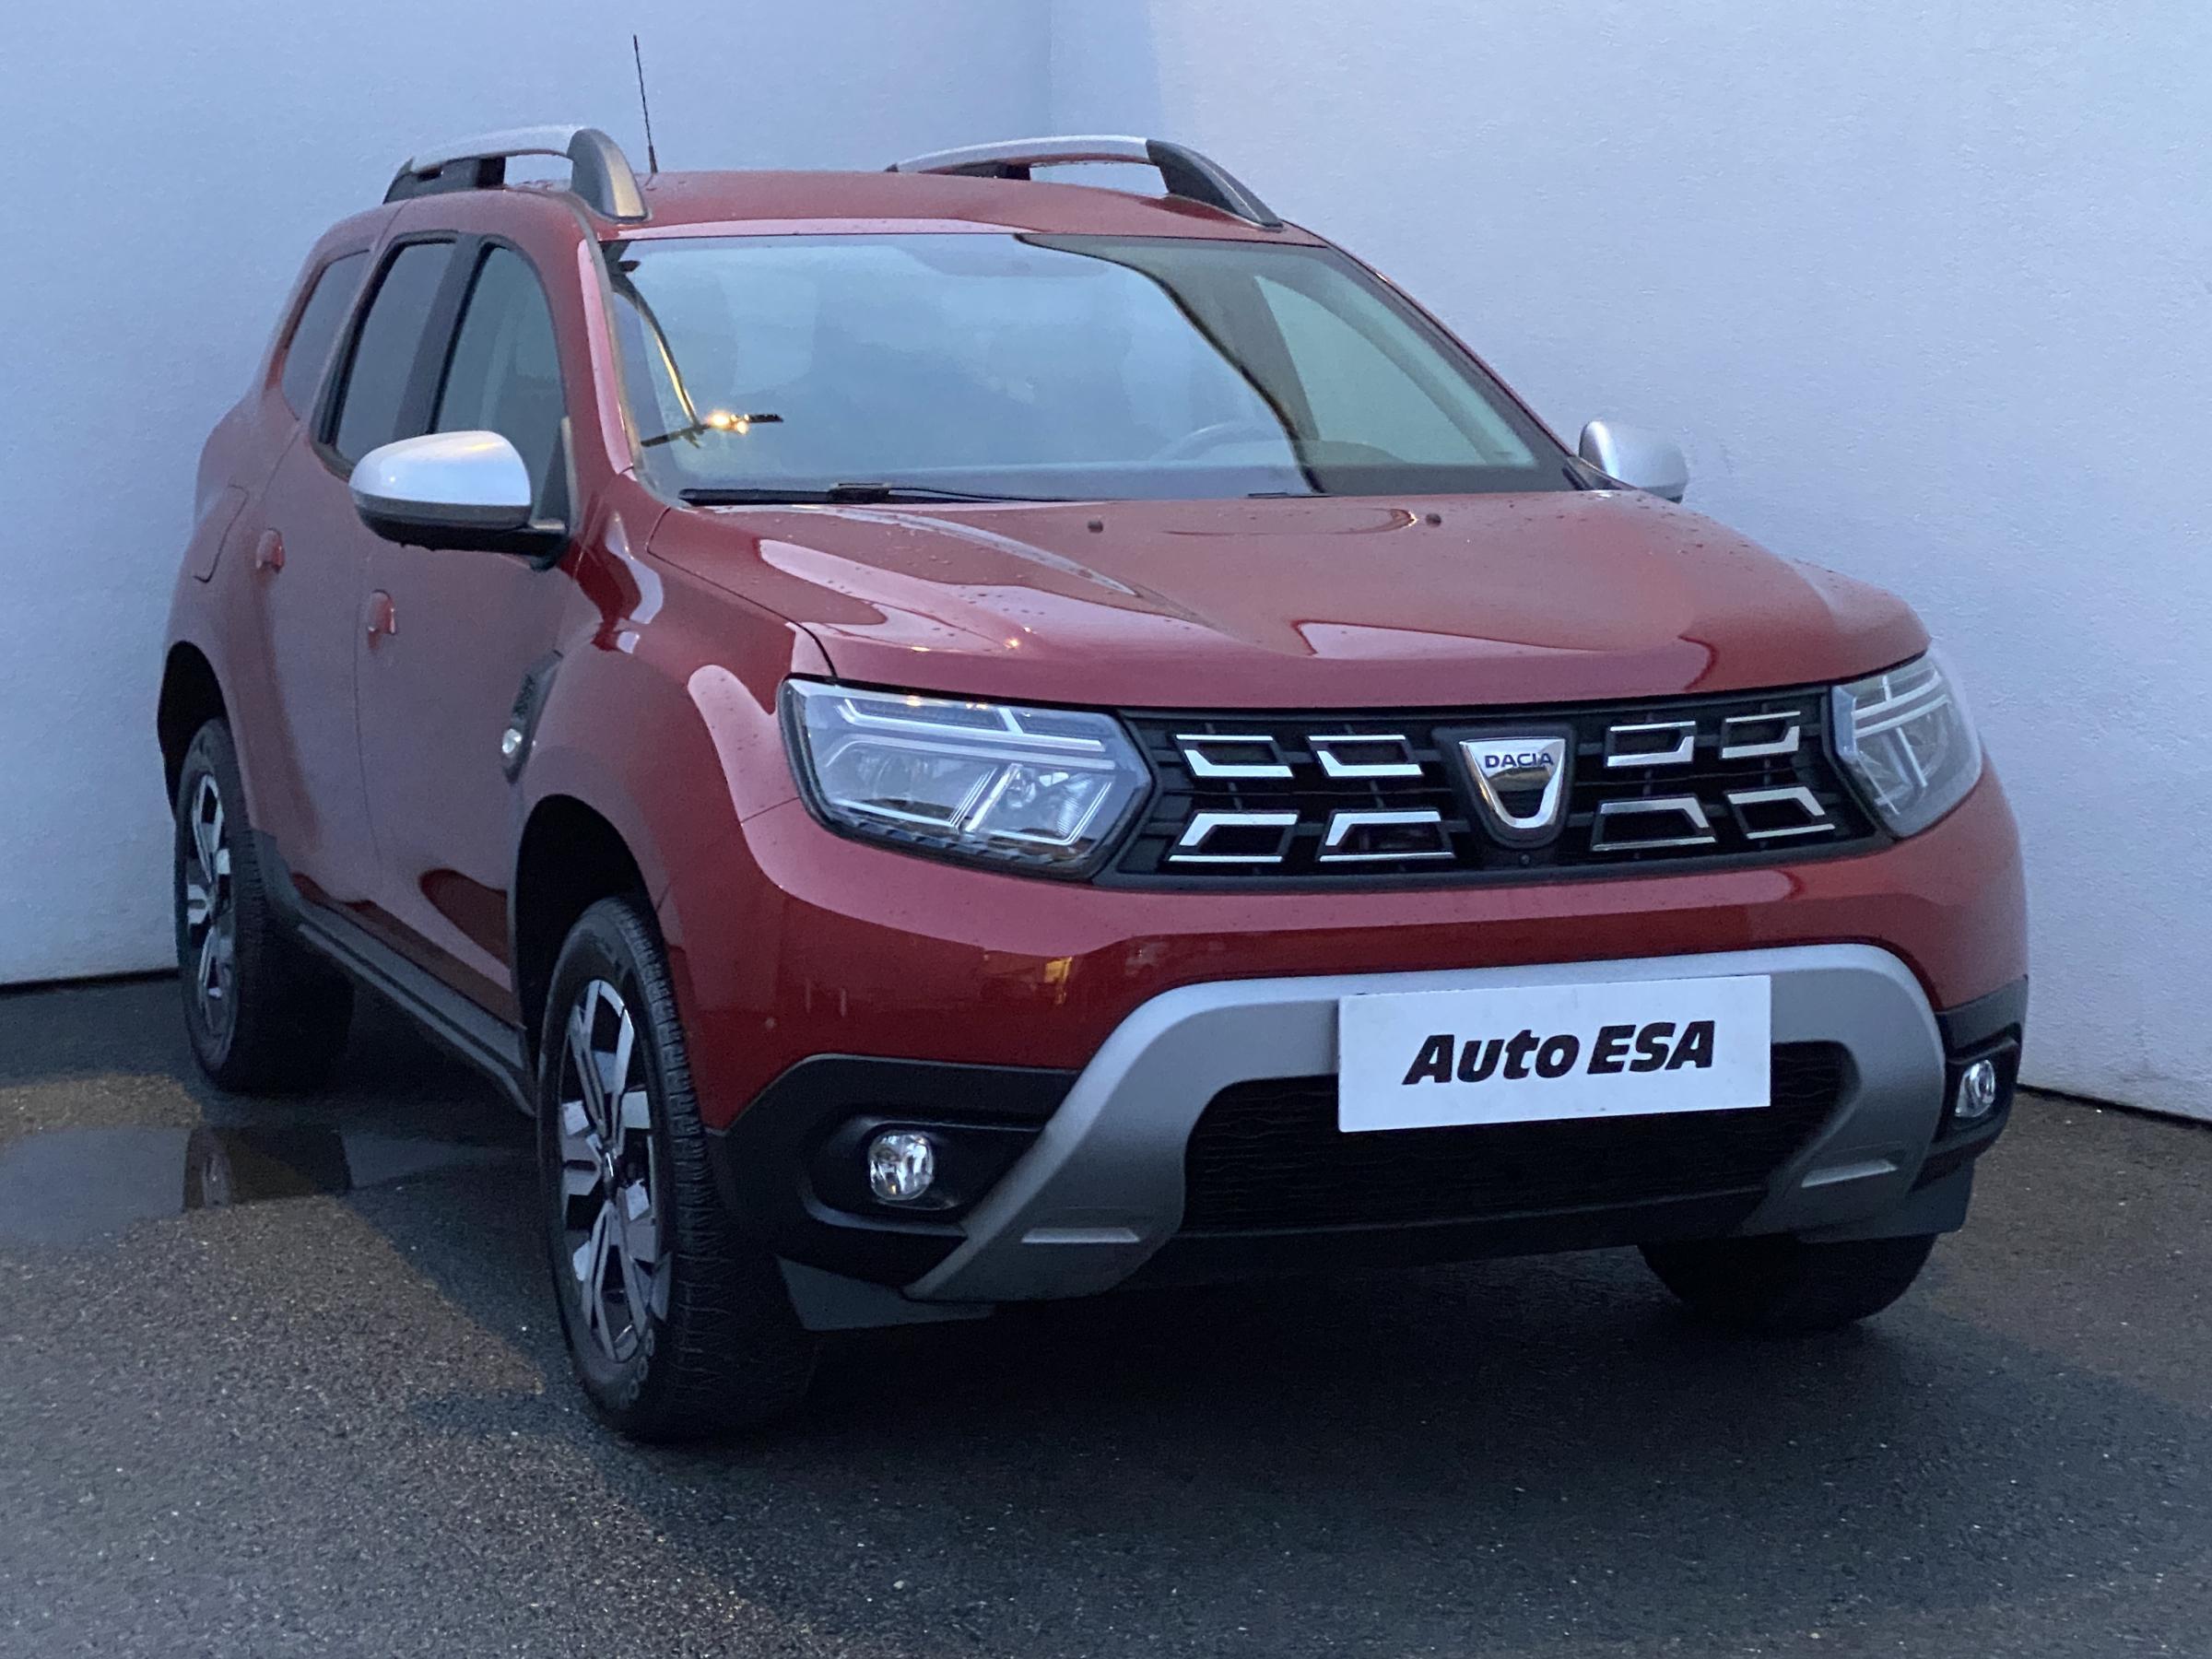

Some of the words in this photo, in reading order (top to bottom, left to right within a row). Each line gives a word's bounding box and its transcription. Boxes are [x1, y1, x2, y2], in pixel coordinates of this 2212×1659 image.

[1484, 752, 1554, 768] DACIA
[1402, 1030, 1580, 1085] Auto
[1586, 1020, 1715, 1075] ESA
